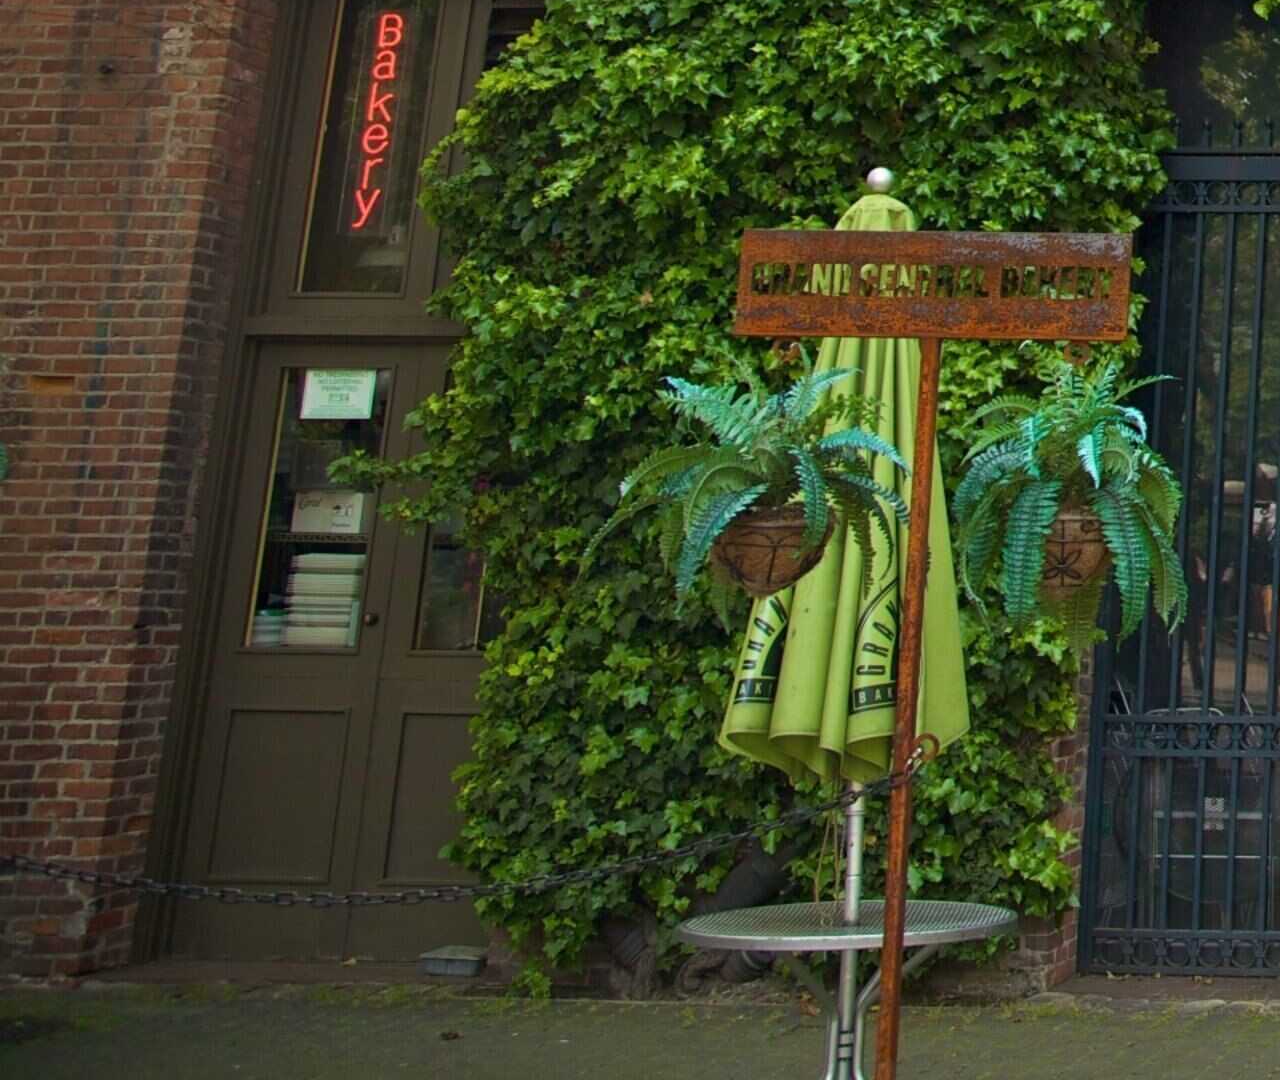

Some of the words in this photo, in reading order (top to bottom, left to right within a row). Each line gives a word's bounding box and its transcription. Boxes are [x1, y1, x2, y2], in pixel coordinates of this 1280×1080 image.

[350, 13, 405, 230] Bakery
[753, 262, 852, 297] GRAND
[858, 262, 990, 299] CENTRAL
[1000, 265, 1116, 300] BAKERY
